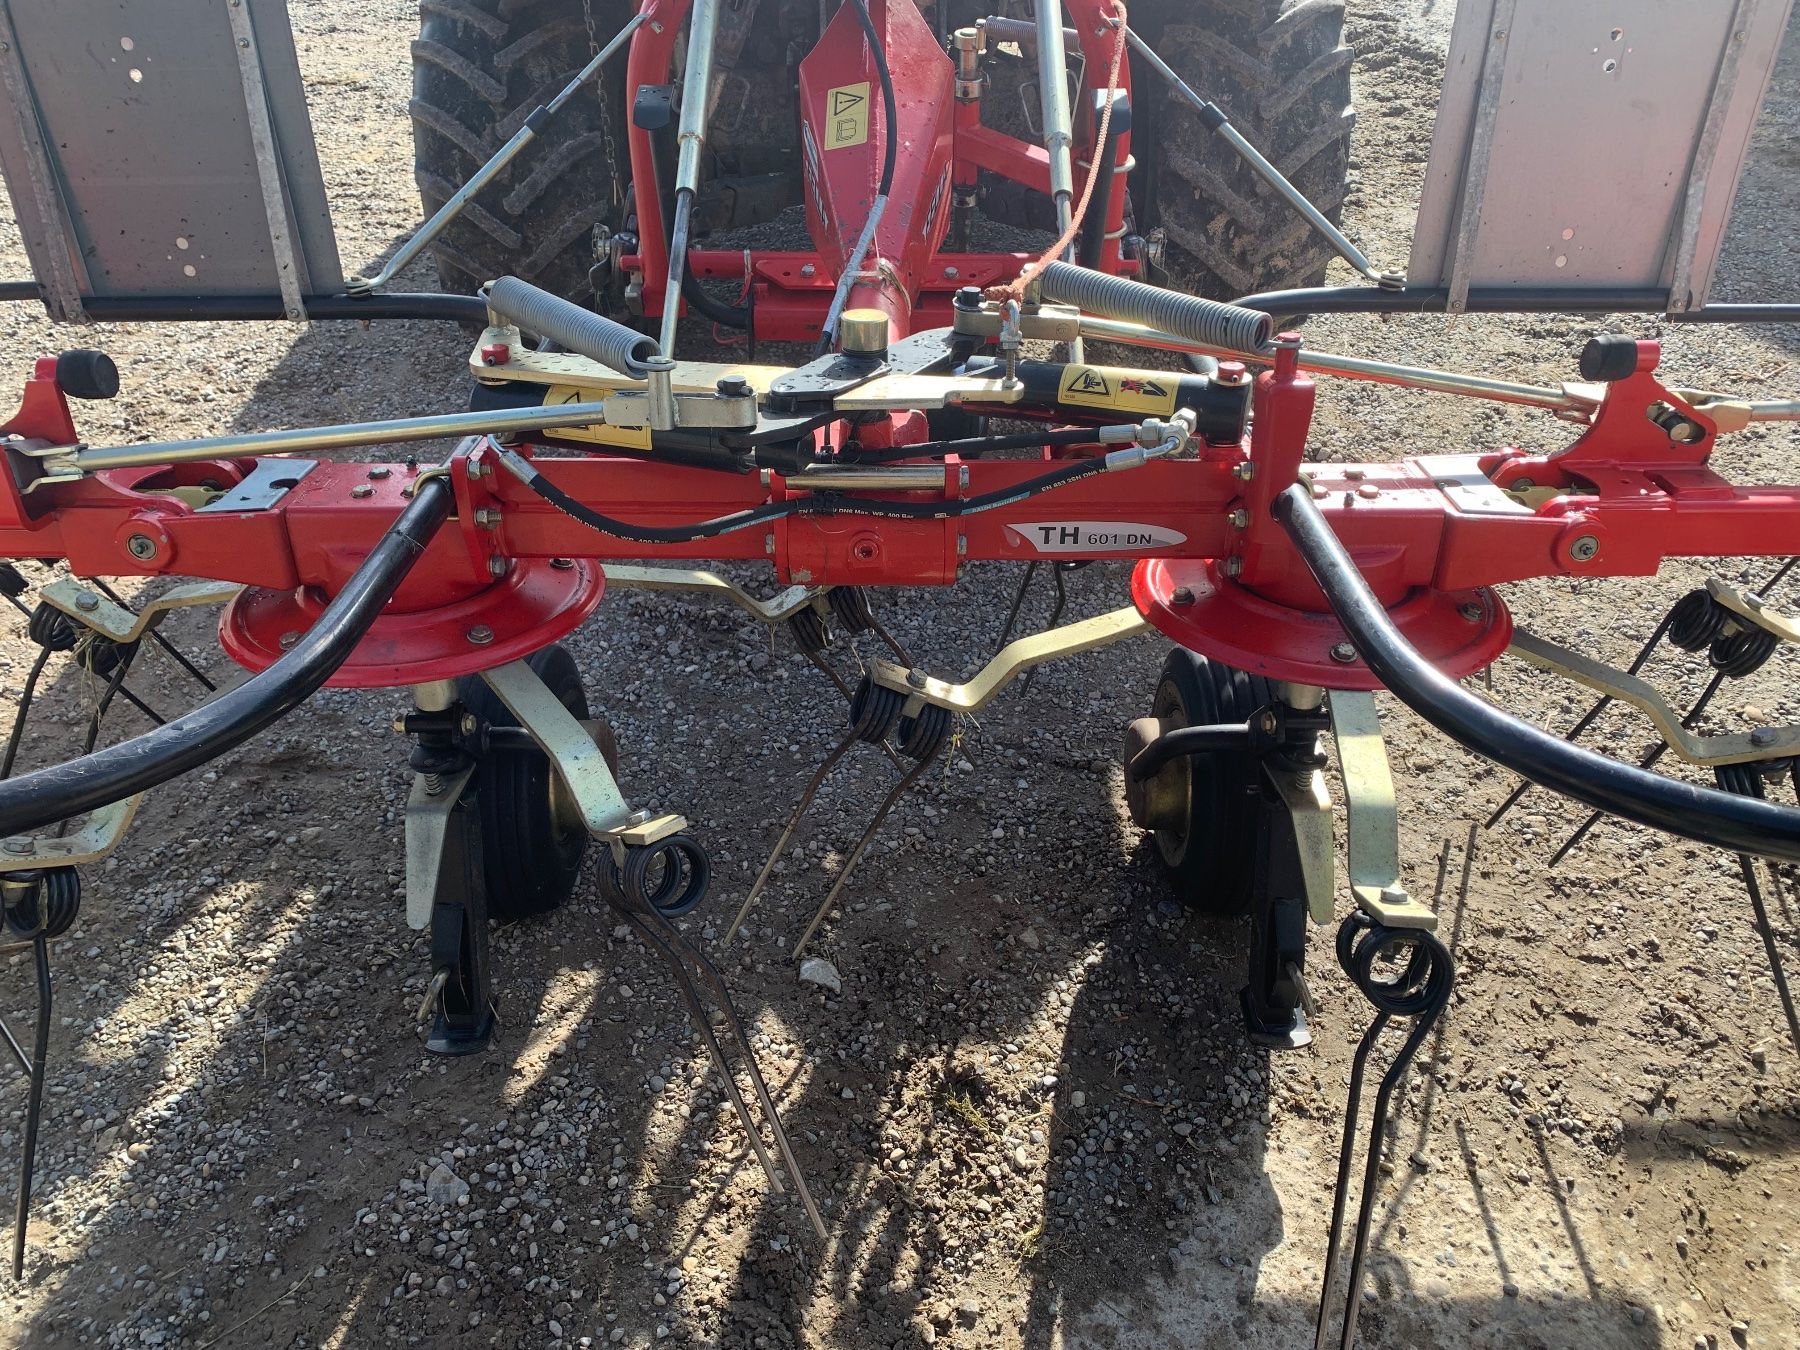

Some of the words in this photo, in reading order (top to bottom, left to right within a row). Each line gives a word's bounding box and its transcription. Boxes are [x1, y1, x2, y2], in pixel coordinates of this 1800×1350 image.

[1038, 526, 1080, 545] TH
[1087, 533, 1118, 545] 601
[1126, 533, 1152, 545] DN
